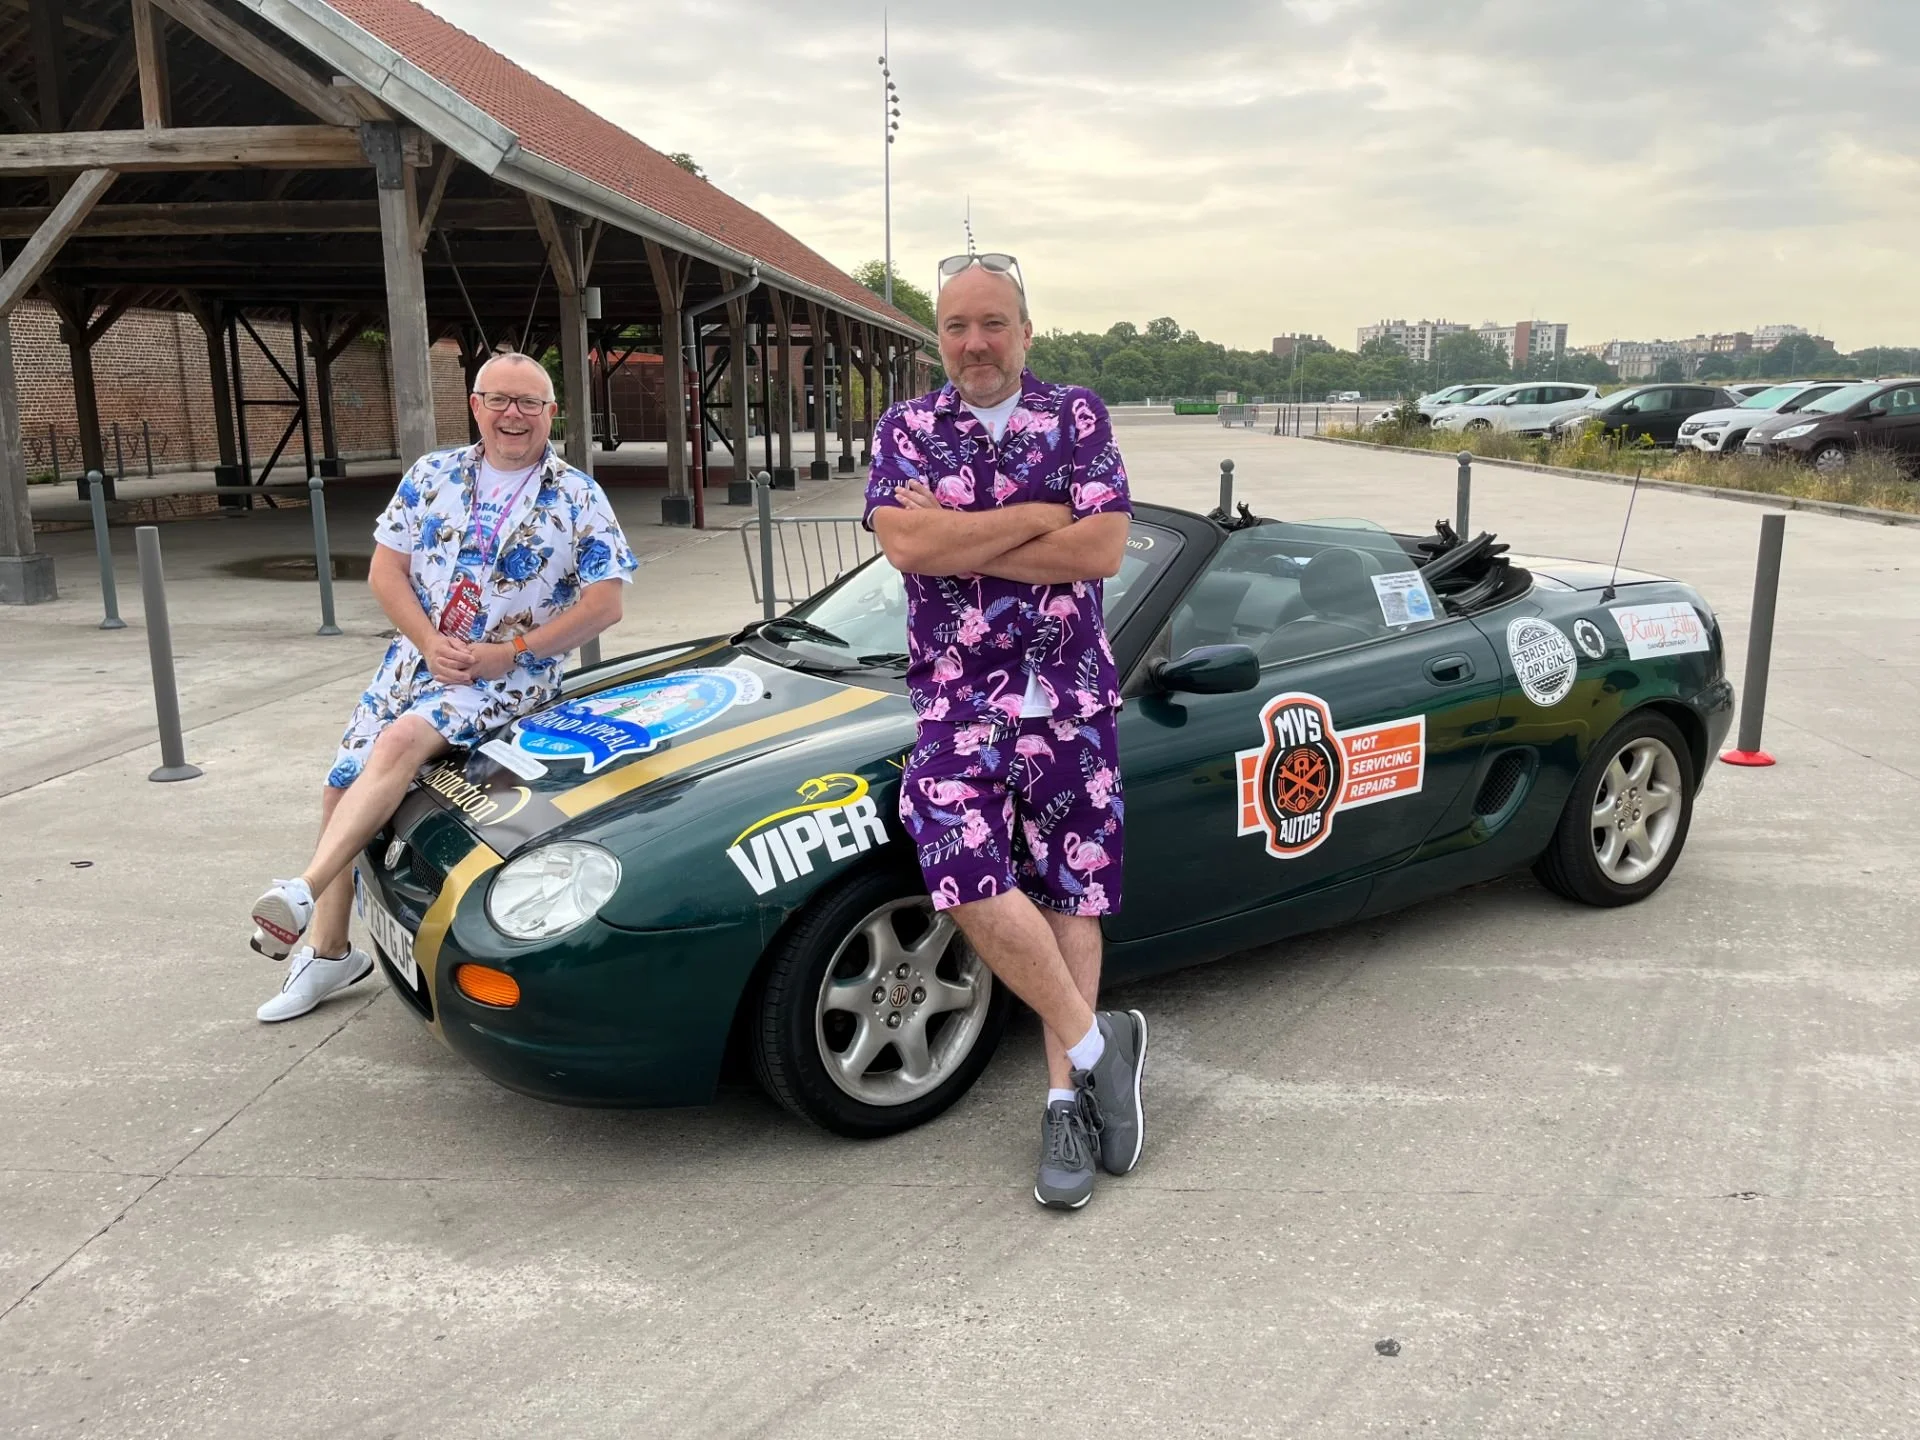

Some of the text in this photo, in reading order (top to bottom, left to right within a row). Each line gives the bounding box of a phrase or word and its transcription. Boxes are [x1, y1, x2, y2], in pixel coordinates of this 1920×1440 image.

[1619, 613, 1665, 648] Ruby
[1523, 639, 1562, 663] BRISTOL
[1528, 653, 1565, 679] DRY GIN
[530, 711, 636, 753] GRAND APPEAL
[1274, 707, 1322, 749] MVS
[1351, 735, 1378, 753] MOT
[1351, 751, 1412, 775] SERVICING
[1349, 776, 1397, 799] REPAIRS
[1279, 811, 1321, 844] AUTOS
[726, 795, 891, 896] VIPER
